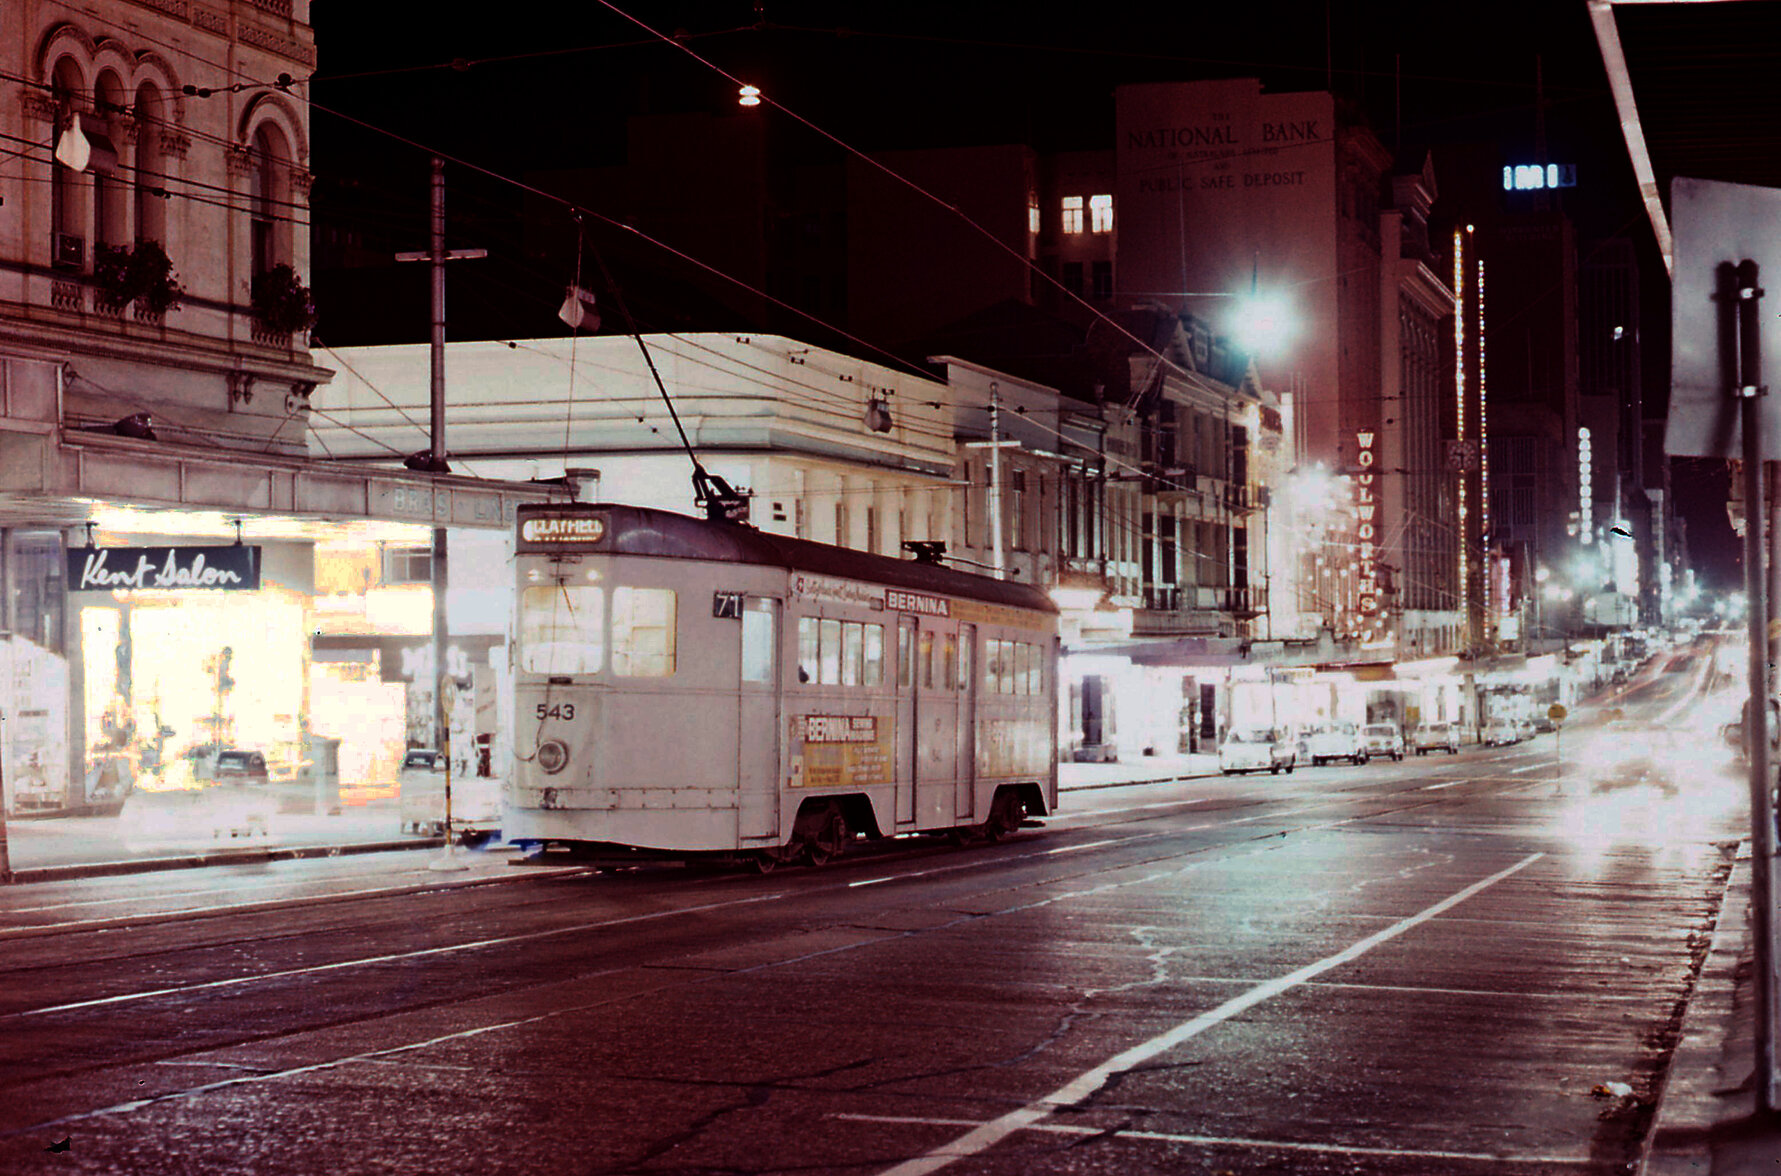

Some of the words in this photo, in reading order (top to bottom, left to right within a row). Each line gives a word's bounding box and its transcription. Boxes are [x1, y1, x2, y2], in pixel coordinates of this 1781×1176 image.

[1128, 126, 1238, 149] NATIONAL
[1263, 120, 1320, 141] BANK
[1139, 176, 1192, 192] PUBLIC
[1200, 175, 1235, 189] SAFE
[1244, 171, 1305, 186] DEPOSIT
[1356, 434, 1374, 612] WOOLWORTHS
[80, 550, 156, 589] Kent
[154, 549, 241, 586] Salon
[716, 594, 739, 617] 71
[888, 592, 948, 616] BERNINA
[536, 704, 575, 721] 543
[808, 716, 850, 742] BERNINA
